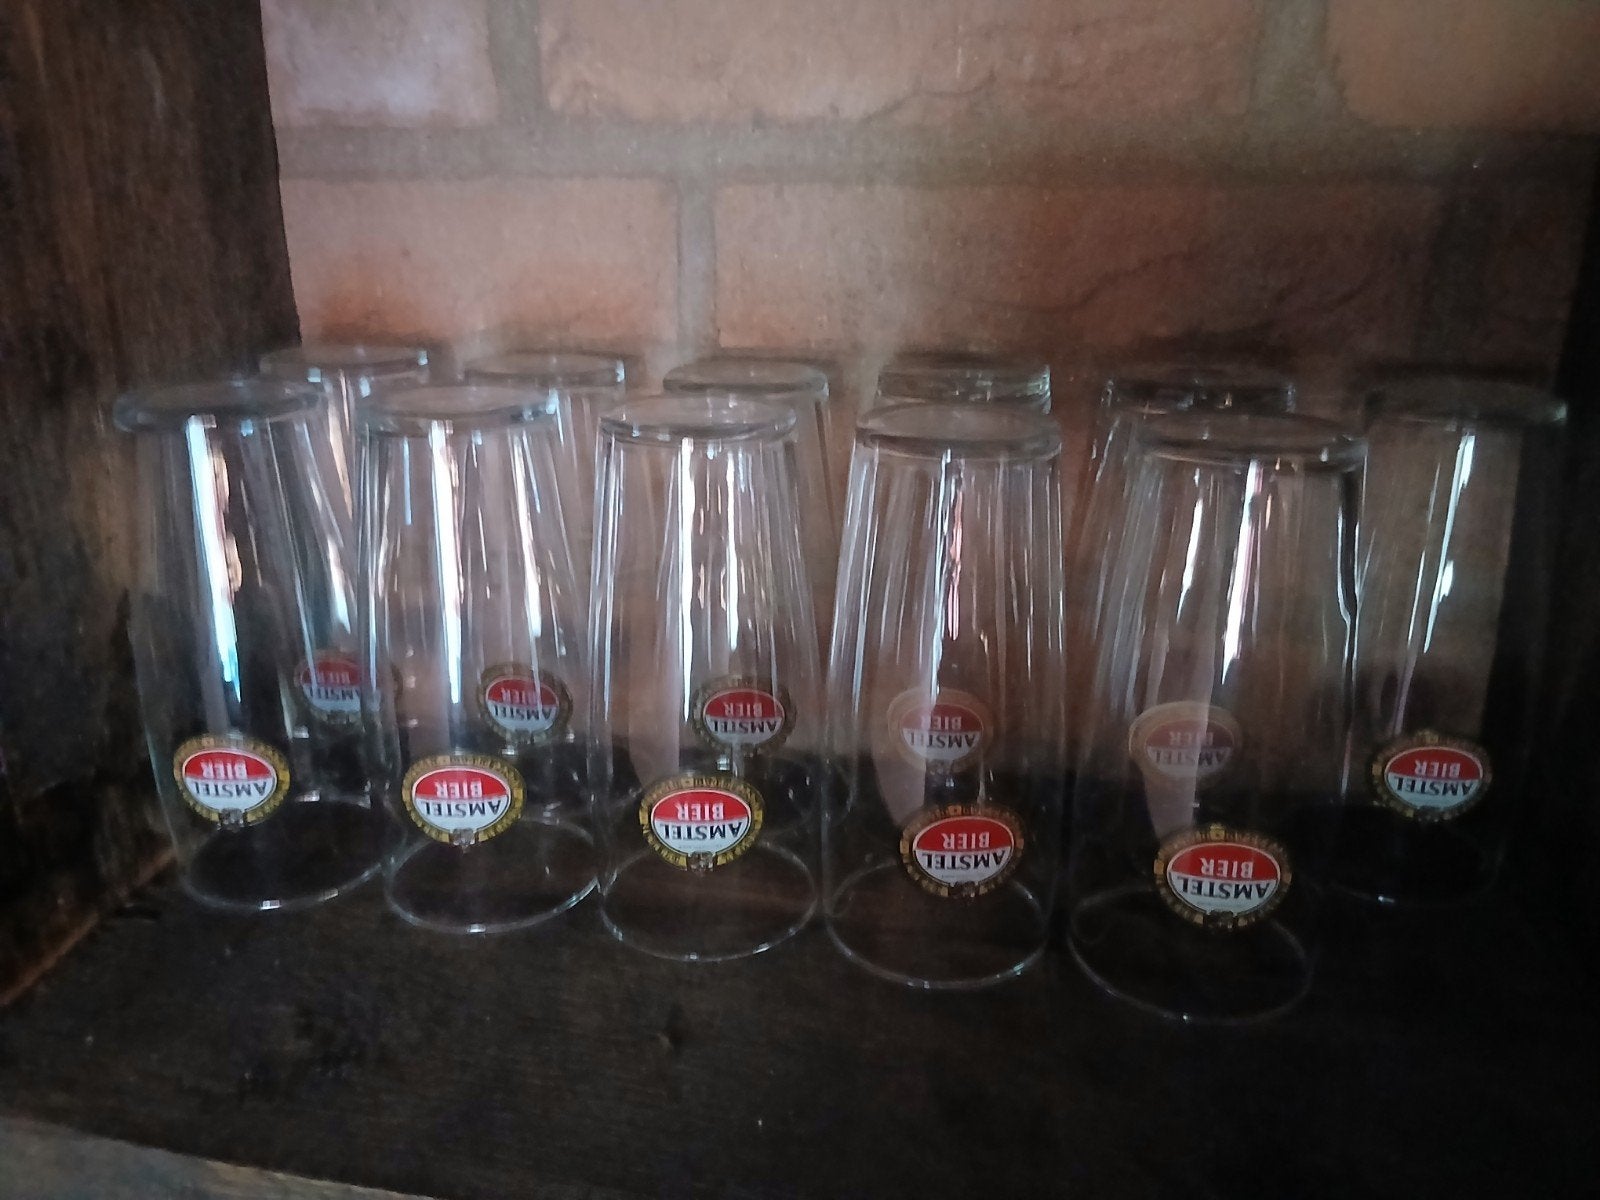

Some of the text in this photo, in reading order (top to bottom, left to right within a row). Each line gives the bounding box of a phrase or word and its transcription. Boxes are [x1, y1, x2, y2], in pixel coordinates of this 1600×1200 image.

[201, 760, 247, 780] BIER
[1414, 759, 1461, 779] BIER
[194, 780, 267, 799] AMSTEL
[434, 778, 483, 799] BIER
[1393, 775, 1475, 797] AMSTEL
[422, 799, 502, 818] AMSTEL
[674, 801, 724, 821] BIER
[660, 820, 743, 841] AMSTEL
[940, 831, 990, 850] BIER
[921, 850, 1007, 871] AMSTEL
[1199, 857, 1254, 879] BIER
[1177, 875, 1271, 901] AMSTEL
